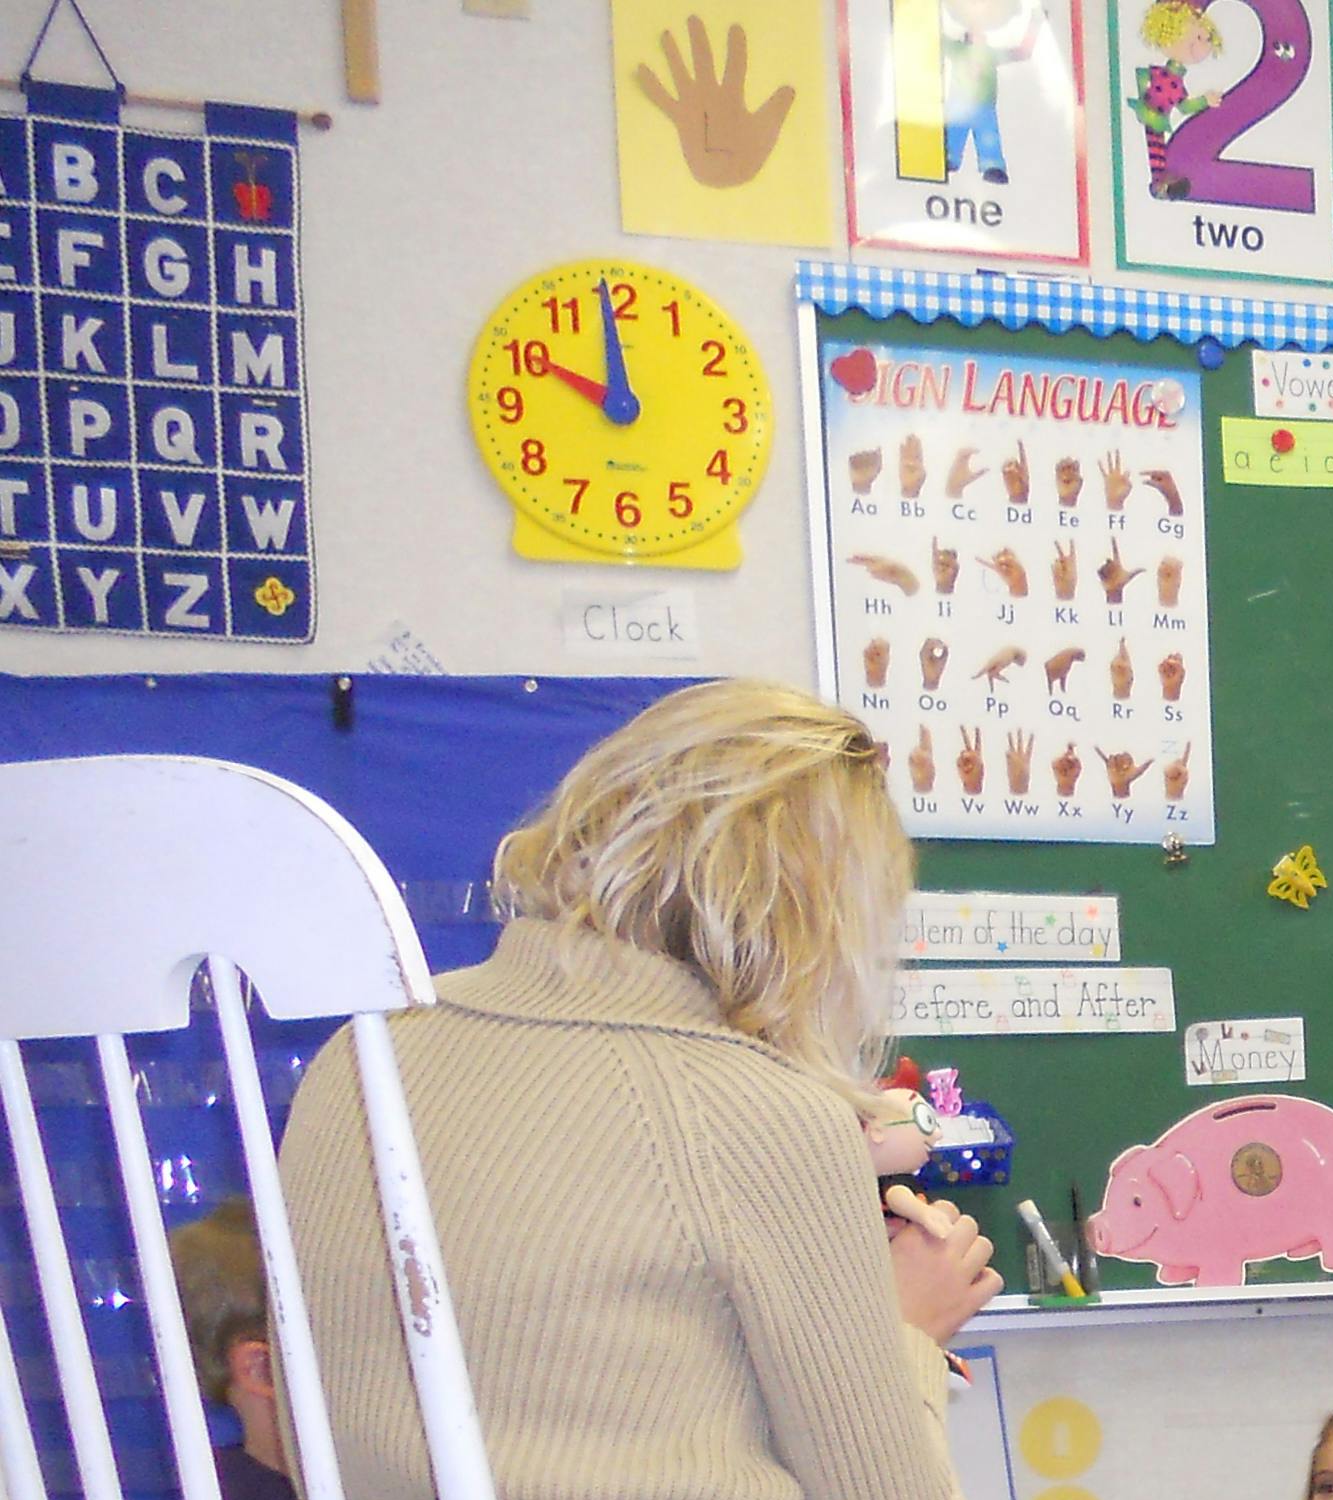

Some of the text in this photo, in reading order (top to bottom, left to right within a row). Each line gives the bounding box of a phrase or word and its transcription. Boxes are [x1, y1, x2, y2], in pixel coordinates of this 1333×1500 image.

[52, 143, 98, 201] B
[143, 157, 188, 216] C
[925, 195, 1003, 227] one
[1193, 214, 1264, 252] two
[57, 229, 104, 287] F
[144, 238, 190, 298] G
[234, 244, 277, 306] H
[542, 297, 580, 334] 11
[661, 300, 680, 337] 1
[61, 314, 285, 388] K L M
[503, 339, 550, 377] 10
[701, 340, 727, 377] 2
[497, 386, 525, 424] 9
[722, 398, 748, 434] 3
[69, 399, 287, 470] P Q R
[521, 439, 547, 476] 8
[706, 449, 732, 485] 4
[563, 478, 590, 515] 7
[614, 491, 642, 528] 6
[668, 482, 693, 518] 5
[73, 485, 295, 550] U V W
[851, 499, 1185, 539] Aa Bb Cc Dd Ee Ff Gg
[78, 567, 210, 629] Y Z
[865, 598, 1187, 631] Hh Ii Jj Kk Ll Mm
[583, 604, 685, 642] Clock
[862, 694, 1184, 722] Nn Oo Pp Qq Rr Ss
[912, 798, 1189, 824] Uu Vv Ww Xx Yy Zz
[974, 910, 1112, 957] of the day
[1011, 983, 1060, 1018] and
[1077, 981, 1157, 1018] After
[1200, 1038, 1296, 1081] Money
